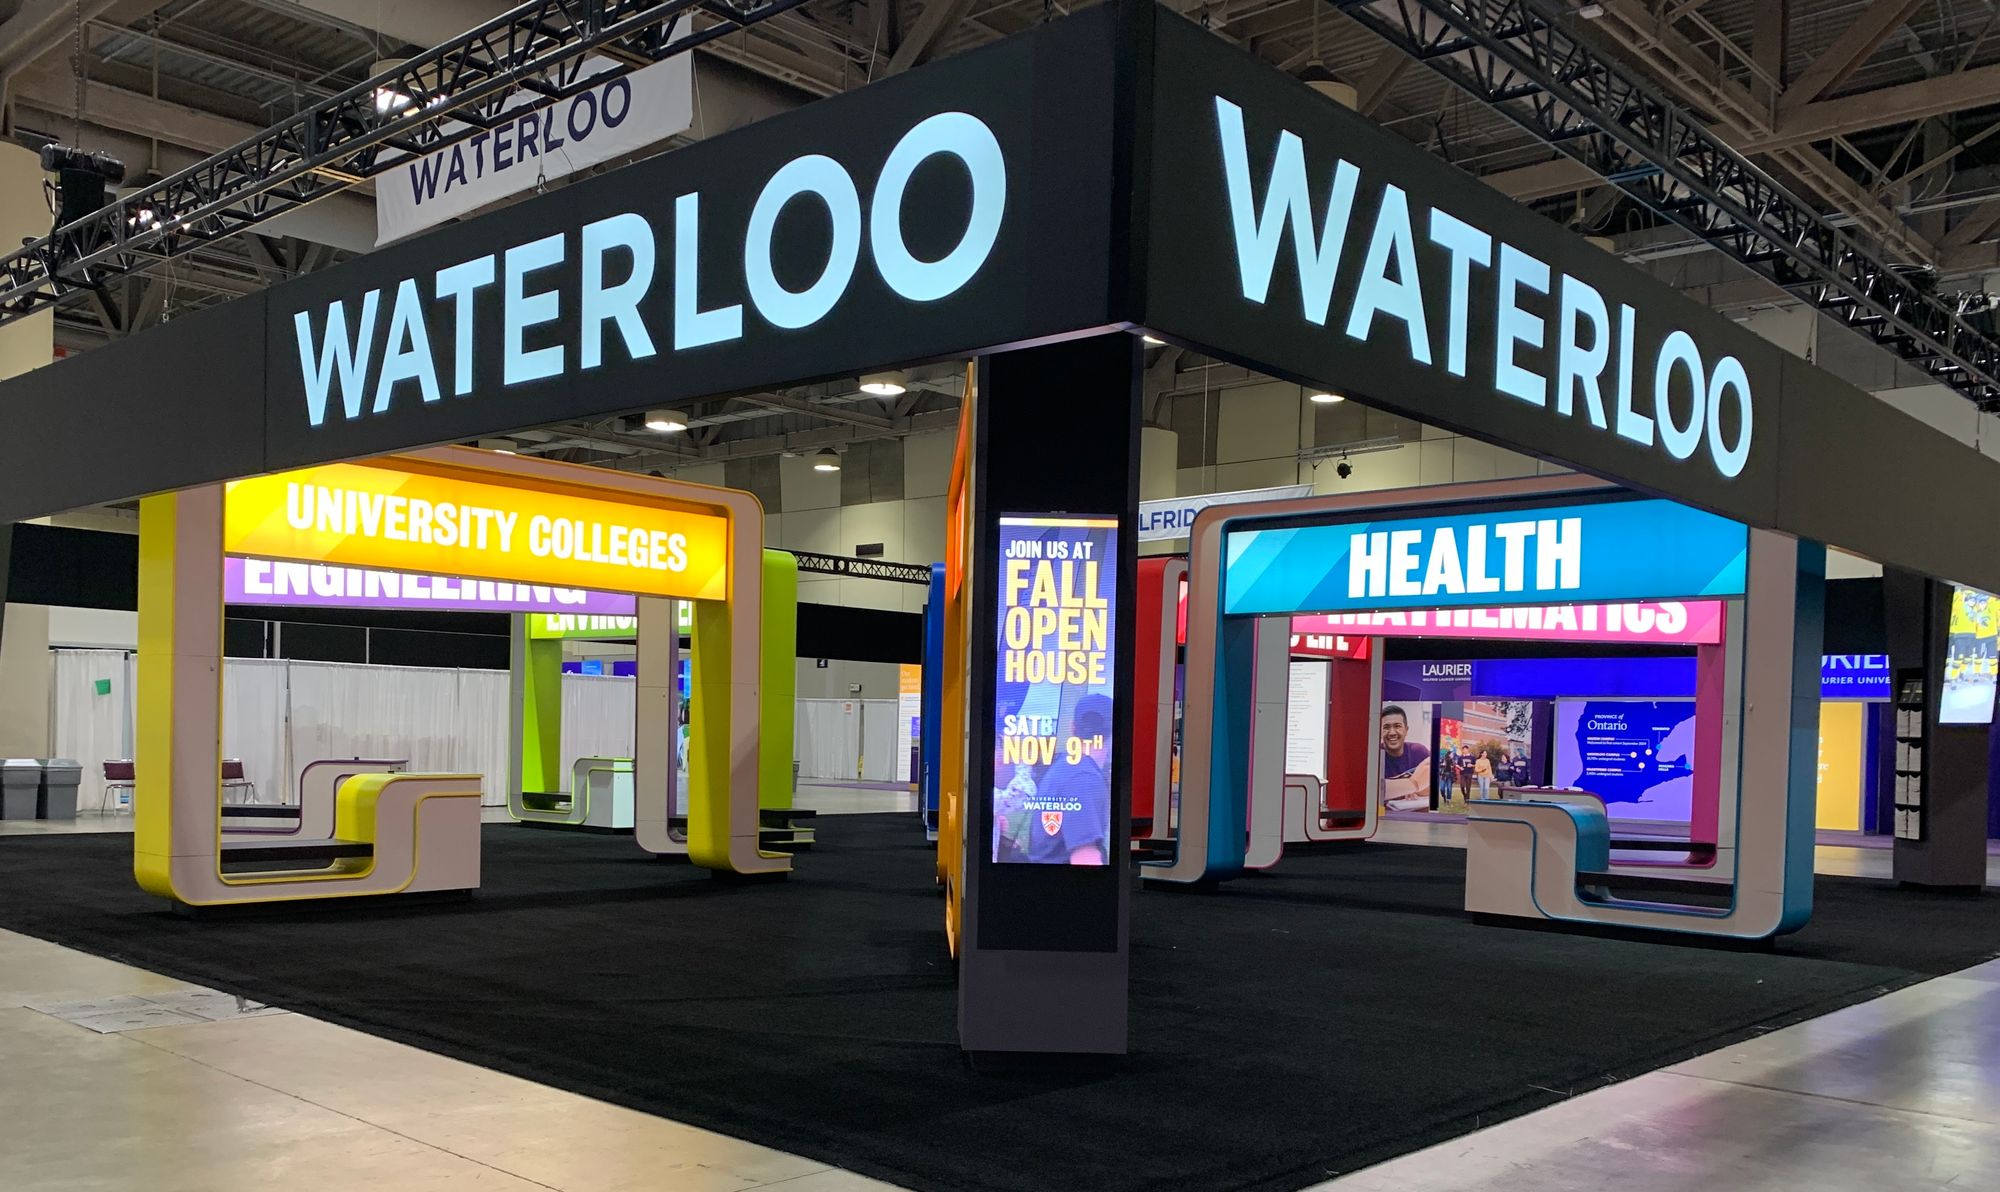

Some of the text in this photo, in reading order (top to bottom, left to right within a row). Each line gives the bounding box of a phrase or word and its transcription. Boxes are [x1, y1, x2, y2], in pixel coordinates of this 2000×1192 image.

[409, 75, 632, 206] WATERLOO
[294, 111, 1007, 427] WATERLOO
[1214, 96, 1754, 479] WATERLOO
[286, 482, 688, 573] UNIVERSITY COLLEGES
[1005, 540, 1093, 559] JOIN US AT
[1347, 516, 1583, 598] HEALTH
[1005, 560, 1108, 607] FALL
[1004, 607, 1108, 651] OPEN
[1004, 650, 1107, 685] HOUSE
[1422, 663, 1472, 676] LAURIER
[1587, 719, 1628, 731] Ontario
[1003, 735, 1057, 766] NOV
[1023, 801, 1083, 811] WATERLOO
